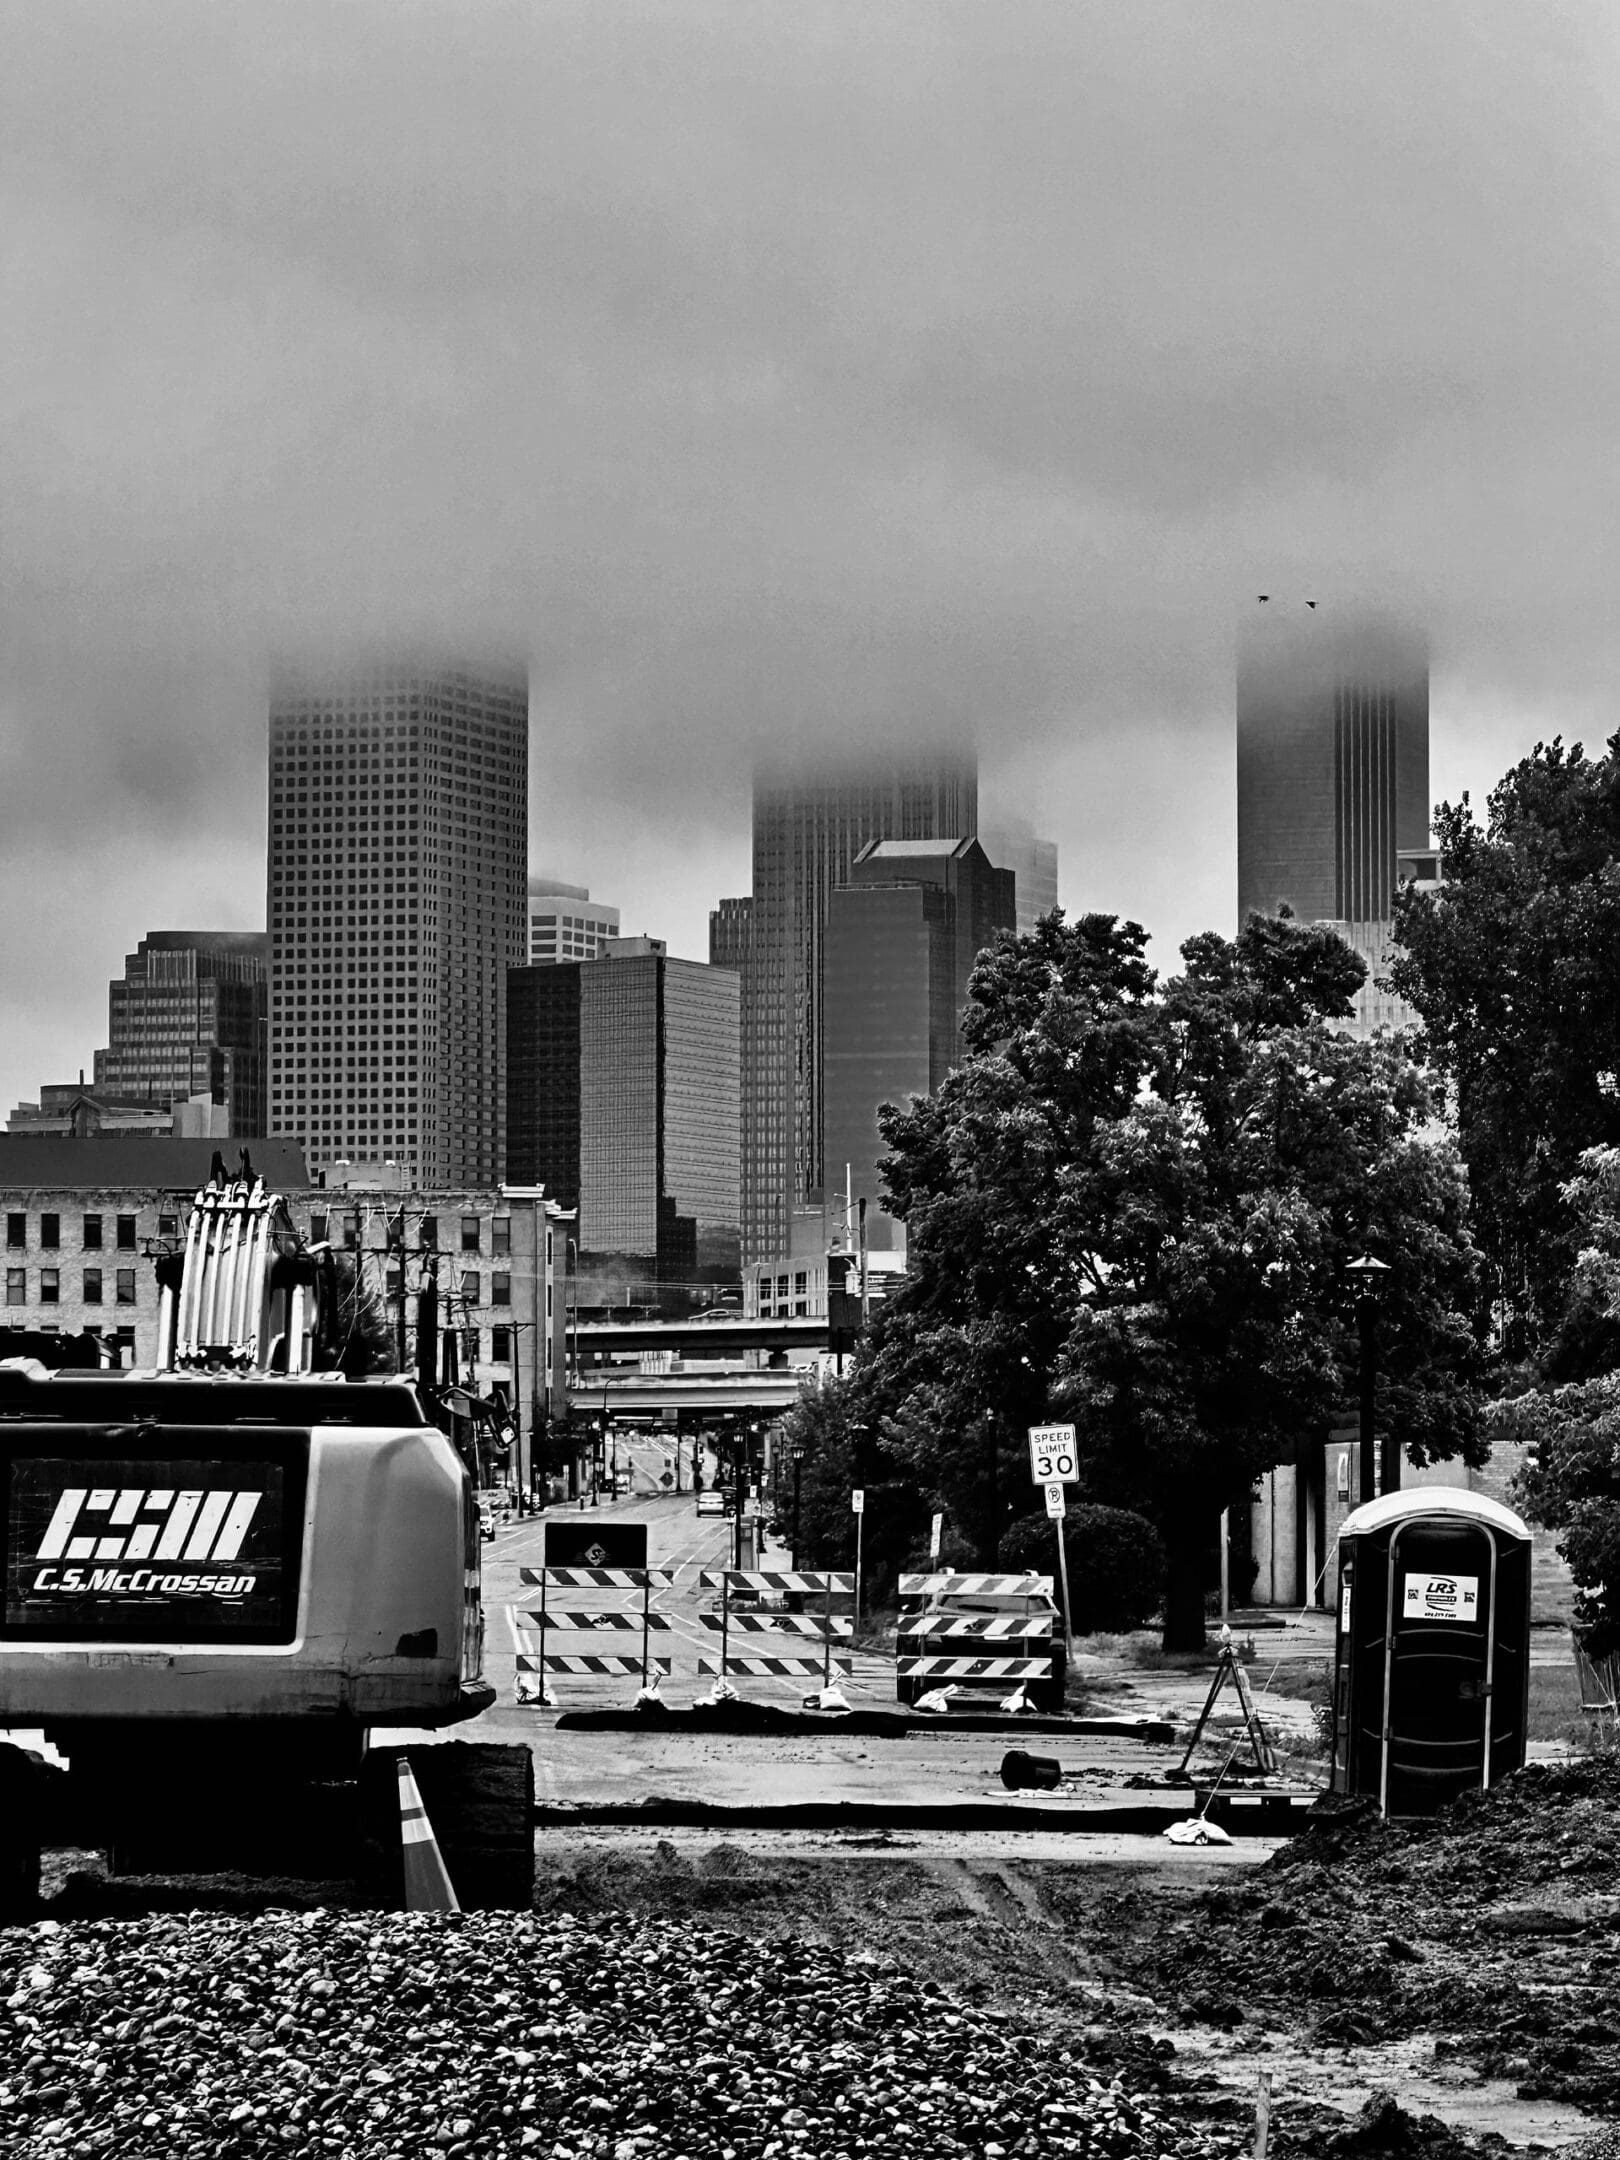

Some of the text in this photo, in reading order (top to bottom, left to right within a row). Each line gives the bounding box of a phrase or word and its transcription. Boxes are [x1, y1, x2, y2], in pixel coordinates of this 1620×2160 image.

[1034, 1432, 1071, 1443] SPEED
[1038, 1443, 1067, 1455] LIMIT
[1038, 1455, 1073, 1477] 30
[1426, 1582, 1458, 1594] LRS
